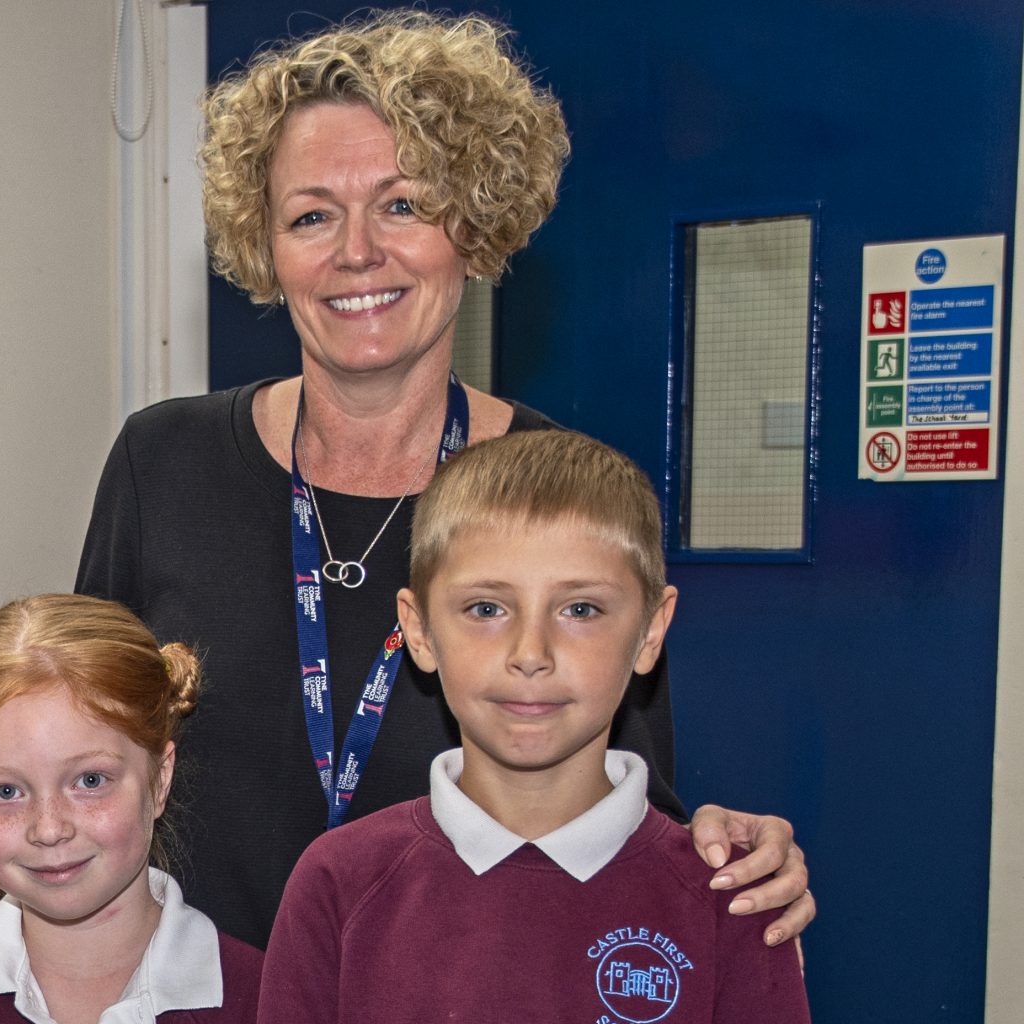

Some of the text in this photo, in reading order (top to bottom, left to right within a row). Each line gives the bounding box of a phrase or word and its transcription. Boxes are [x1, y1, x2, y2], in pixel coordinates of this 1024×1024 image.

[922, 256, 941, 264] Fire
[916, 266, 945, 275] action
[910, 299, 985, 311] Operate the nearest
[910, 312, 924, 320] fire
[910, 341, 977, 352] Leave the building
[909, 355, 919, 363] by
[933, 352, 962, 360] nearest
[908, 362, 958, 372] available exit
[908, 383, 985, 394] Report to the person
[916, 394, 942, 403] charge
[943, 393, 952, 401] of
[953, 393, 966, 401] the
[908, 404, 942, 413] assembly
[943, 404, 963, 413] point
[907, 432, 918, 440] Do
[919, 432, 932, 440] not
[947, 431, 959, 439] lift
[906, 441, 977, 451] Do not re-enter the
[906, 451, 955, 461] building until
[906, 462, 945, 470] authorised
[946, 461, 955, 469] to
[956, 461, 966, 469] do
[587, 927, 694, 970] CASTLE FIRST
